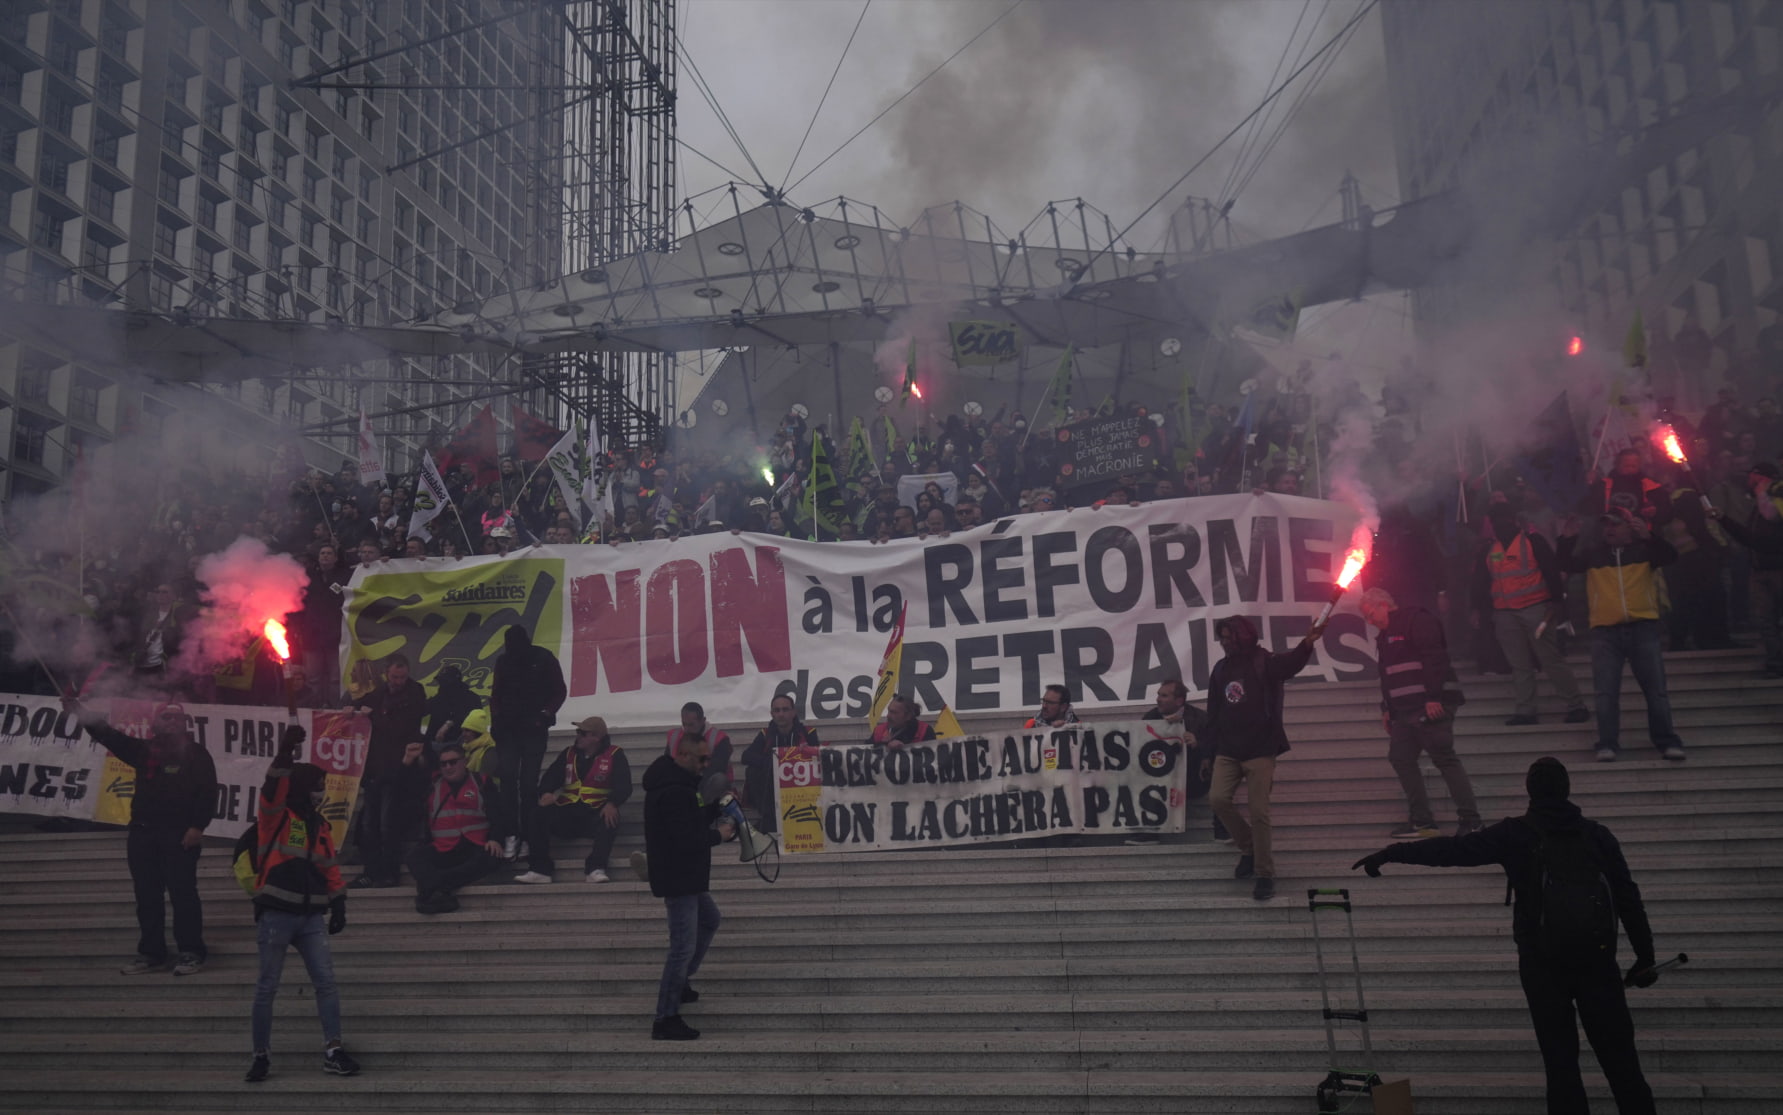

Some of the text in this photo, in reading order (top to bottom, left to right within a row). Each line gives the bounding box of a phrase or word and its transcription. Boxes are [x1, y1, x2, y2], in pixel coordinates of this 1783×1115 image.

[1071, 430, 1085, 441] NE
[1076, 454, 1144, 480] MACRONIE
[569, 546, 792, 697] NON
[802, 575, 833, 635] à
[852, 575, 902, 634] la
[924, 516, 1339, 629] RÉFORME
[316, 732, 365, 770] cgt
[820, 736, 992, 788] REFORME
[779, 756, 823, 786] cgt
[824, 801, 876, 844] ON
[890, 785, 1073, 842] LACHERA
[1083, 783, 1169, 829] PAS
